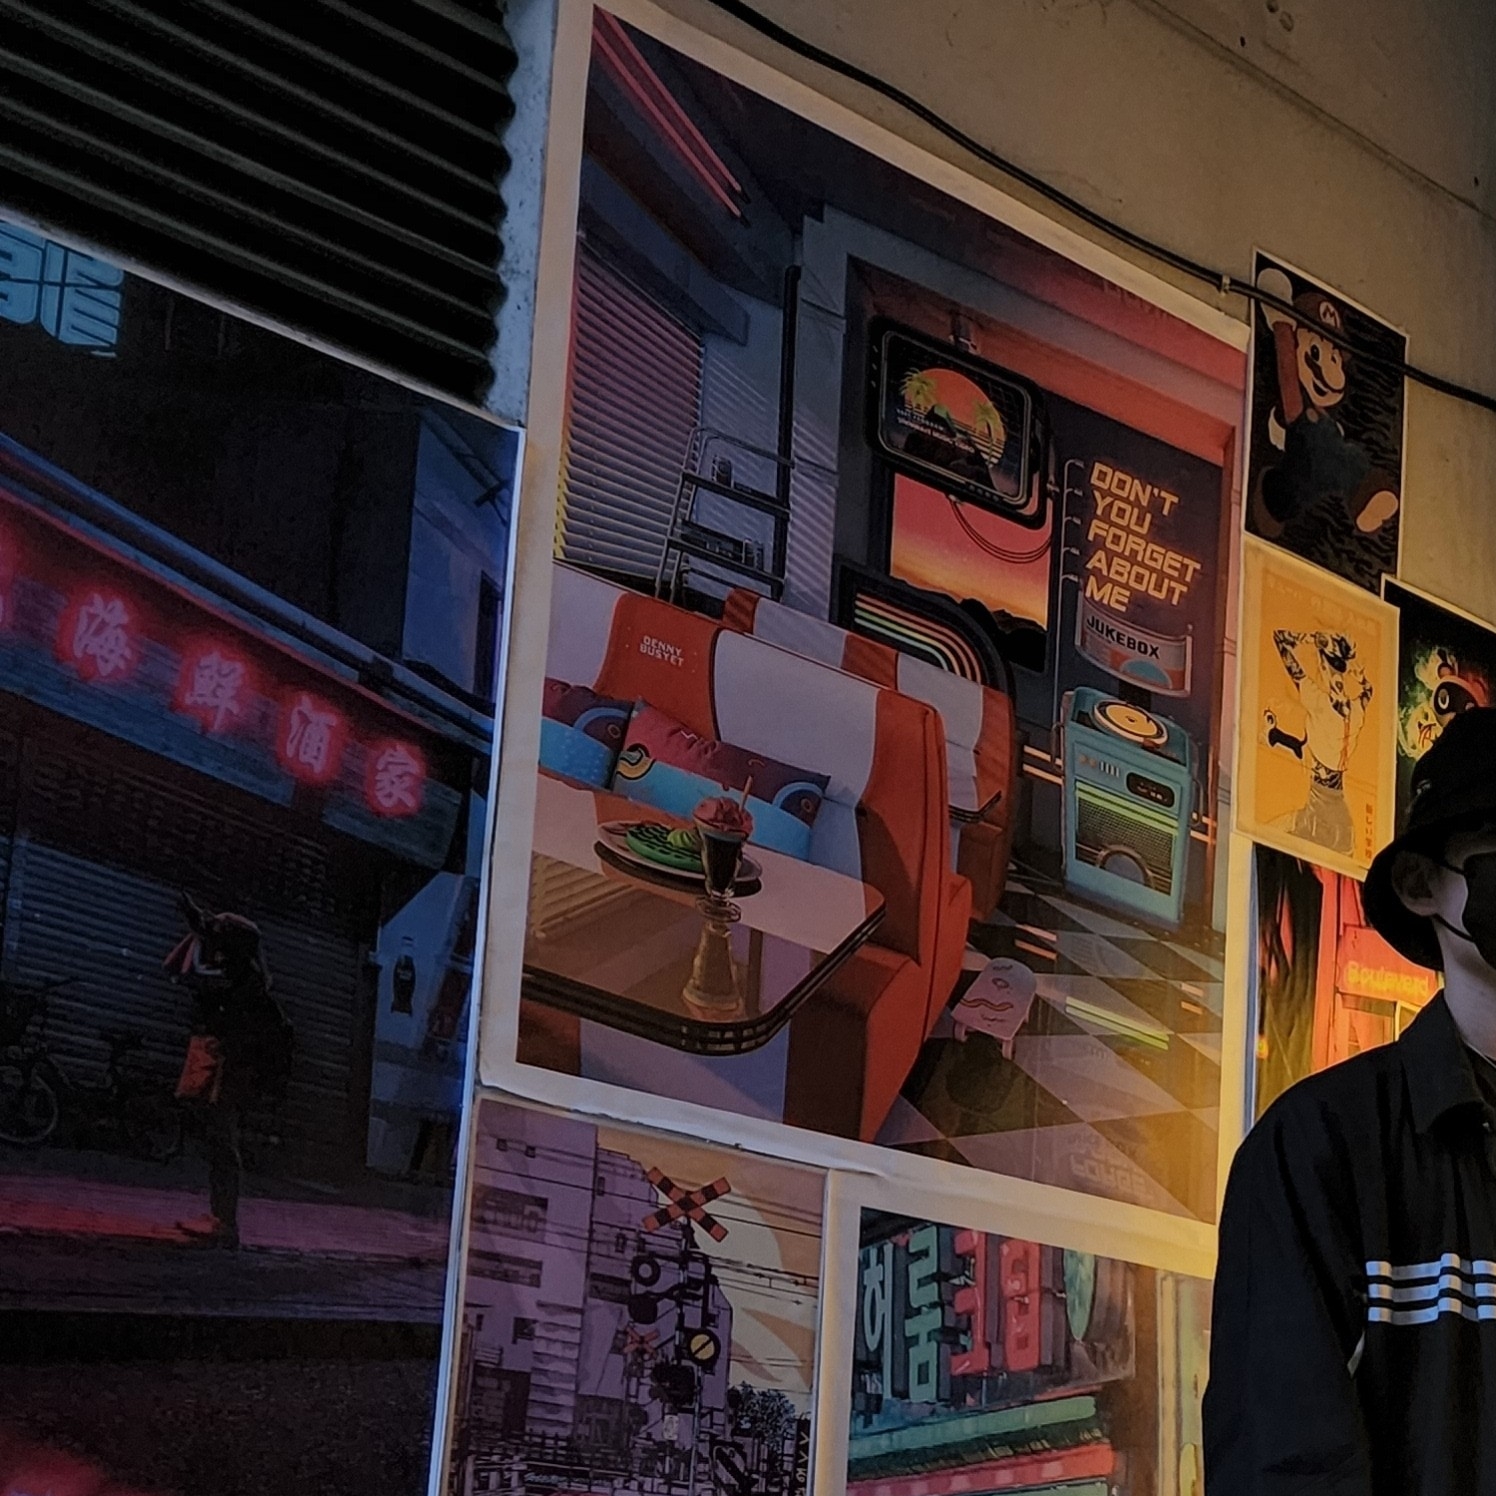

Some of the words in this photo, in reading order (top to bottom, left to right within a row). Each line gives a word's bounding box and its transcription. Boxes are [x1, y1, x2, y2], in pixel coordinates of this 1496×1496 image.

[1090, 461, 1180, 517] DON'T
[1092, 490, 1153, 535] YOU
[1087, 520, 1202, 583] FORGET
[1085, 575, 1131, 613] ME
[1086, 550, 1189, 606] ABOUT
[642, 634, 683, 657] DENNY
[1086, 616, 1161, 660] JUKEBOX
[0, 591, 425, 810] 海鮮酒家
